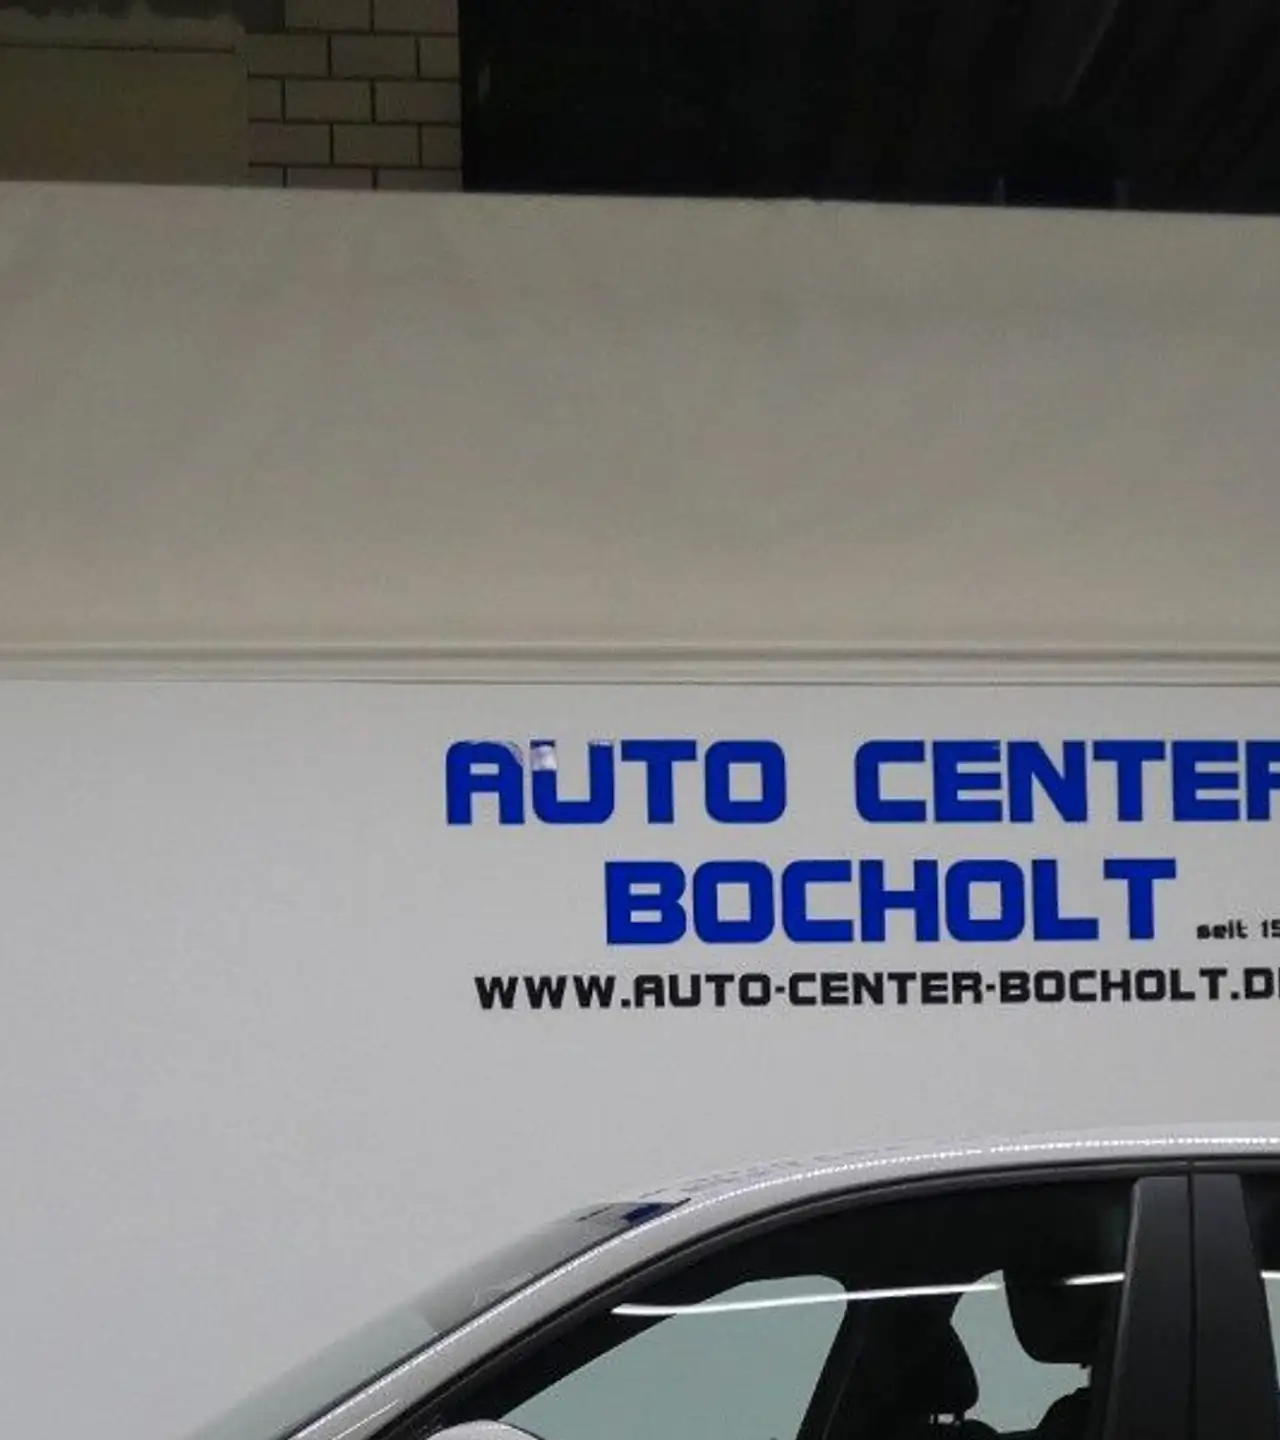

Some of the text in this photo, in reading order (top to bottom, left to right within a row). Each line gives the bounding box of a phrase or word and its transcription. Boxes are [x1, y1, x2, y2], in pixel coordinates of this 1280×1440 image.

[445, 739, 788, 828] AUTO
[605, 858, 1178, 947] BOCHOLT
[1196, 919, 1248, 940] seit
